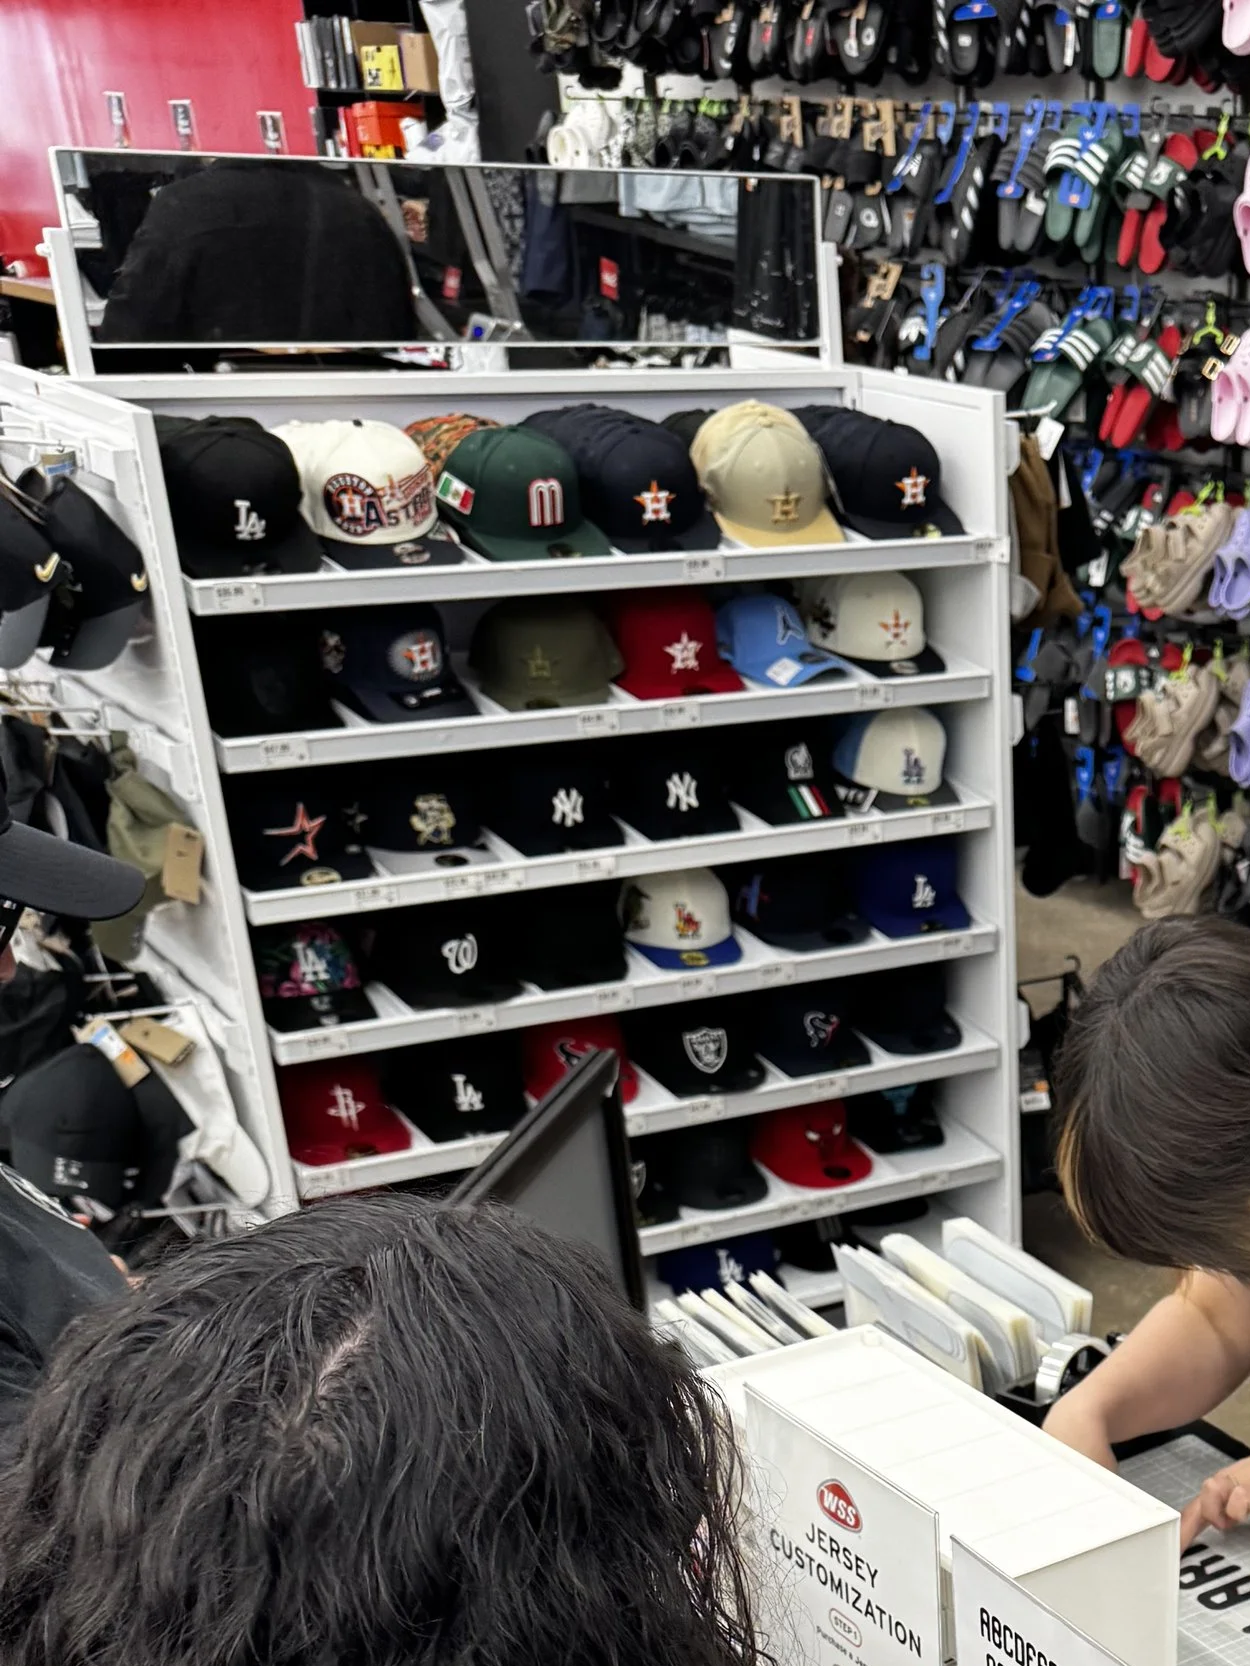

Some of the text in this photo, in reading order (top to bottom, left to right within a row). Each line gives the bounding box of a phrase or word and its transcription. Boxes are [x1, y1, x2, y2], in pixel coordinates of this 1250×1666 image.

[234, 500, 266, 540] LA
[641, 490, 671, 521] H
[552, 787, 584, 828] NY
[666, 771, 699, 812] NY
[911, 874, 936, 909] LA
[291, 940, 331, 982] LA
[451, 1073, 485, 1112] LA
[822, 1487, 858, 1527] WSS
[806, 1523, 878, 1588] JERSEY
[769, 1528, 922, 1658] CUSTOMIZATION
[816, 1624, 846, 1656] Purchase
[834, 1616, 858, 1640] STEP 1
